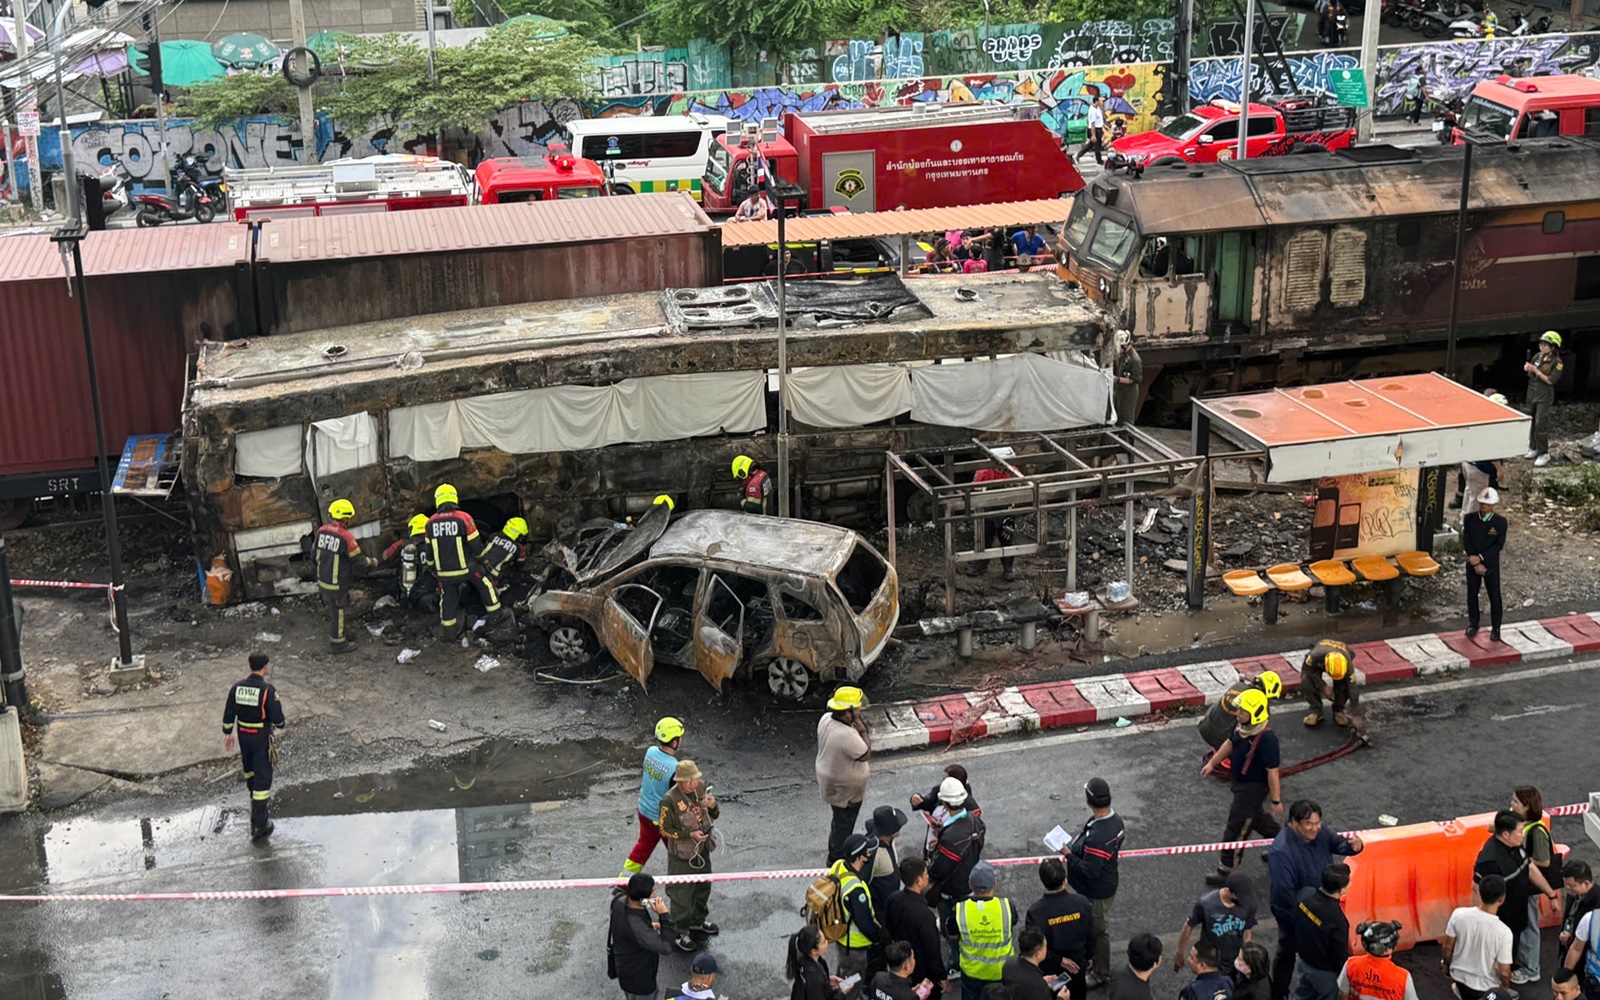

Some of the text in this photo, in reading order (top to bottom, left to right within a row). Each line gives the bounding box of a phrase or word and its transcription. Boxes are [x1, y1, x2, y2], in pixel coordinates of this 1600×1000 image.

[886, 152, 1024, 171] สำนักป้องกันและบรรเทาสาธารณภัย
[925, 168, 989, 182] กรุงเทพมหานคร
[48, 477, 80, 491] SRT
[432, 520, 459, 537] BFRD
[317, 533, 340, 553] BFRD
